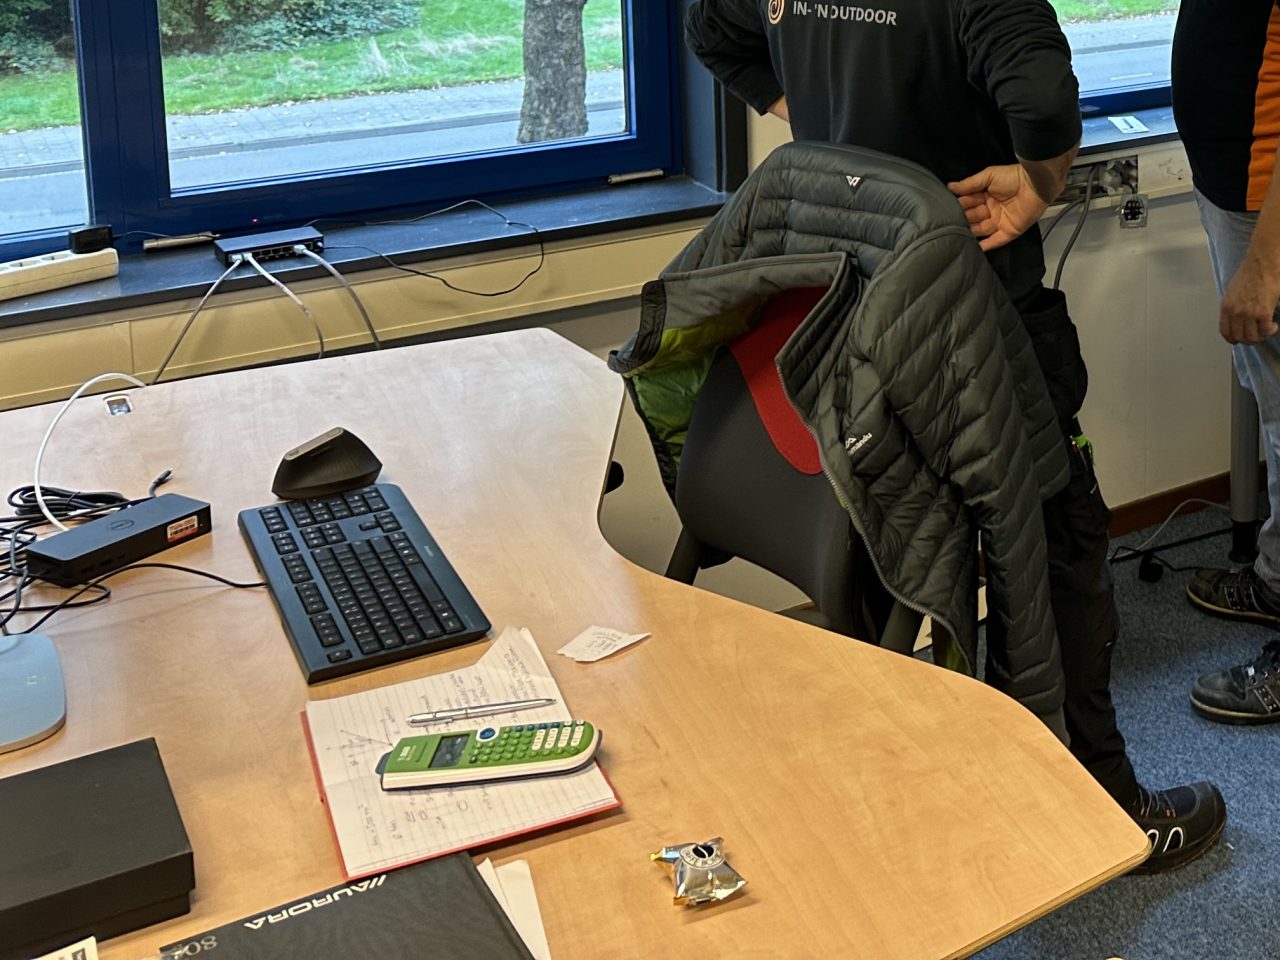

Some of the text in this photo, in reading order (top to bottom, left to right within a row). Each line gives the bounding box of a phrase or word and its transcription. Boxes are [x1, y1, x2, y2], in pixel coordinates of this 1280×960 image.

[793, 0, 812, 16] IN-
[830, 5, 897, 26] OUTDOOR
[244, 882, 369, 930] AURORA
